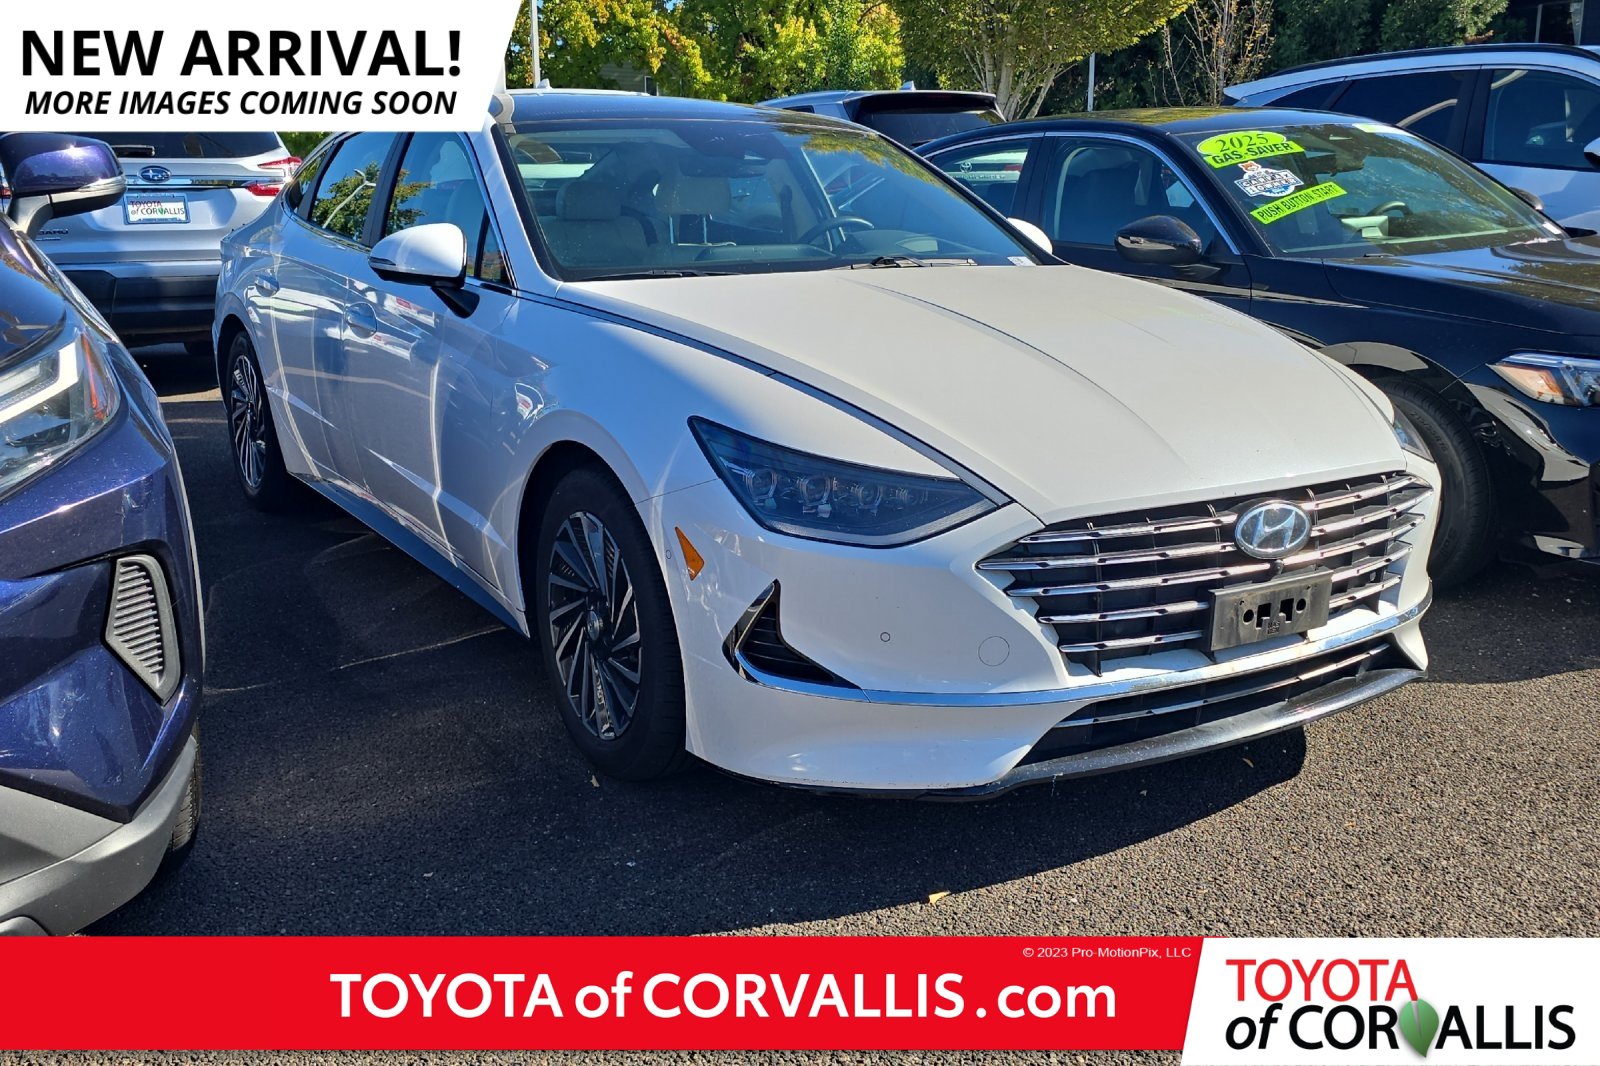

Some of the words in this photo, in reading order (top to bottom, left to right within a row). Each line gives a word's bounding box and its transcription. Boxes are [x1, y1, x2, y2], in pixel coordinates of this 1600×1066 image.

[1215, 134, 1269, 152] 2025
[130, 200, 162, 208] TOYOTA
[1257, 203, 1284, 220] PUSH
[1281, 192, 1315, 211] BUTTON
[1311, 185, 1336, 199] START
[131, 207, 140, 215] of
